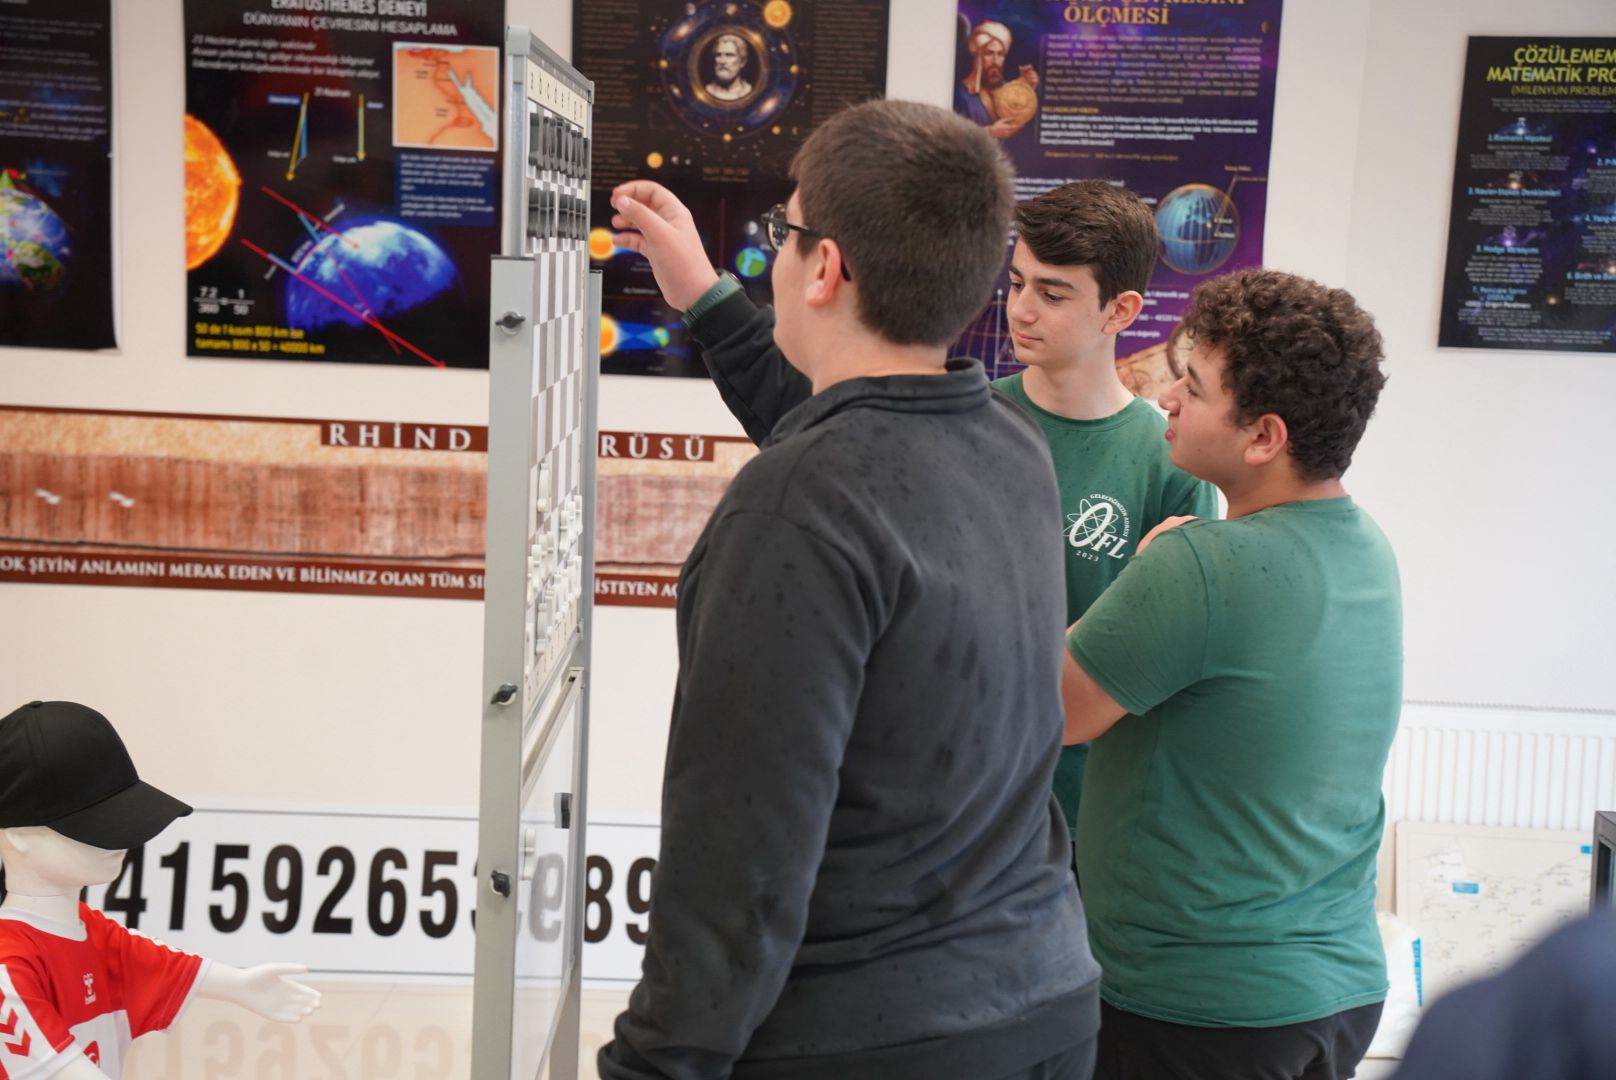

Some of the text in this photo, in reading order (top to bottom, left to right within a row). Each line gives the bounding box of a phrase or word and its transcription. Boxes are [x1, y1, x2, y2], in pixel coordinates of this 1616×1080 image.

[243, 11, 459, 36] DÜNYANIN ÇEVRESİNİ HESAPLAMA
[1063, 2, 1169, 27] ÖLÇMESİ
[1487, 64, 1582, 82] MATEMATİK
[329, 422, 705, 460] RHİND RÜSÜ
[1076, 550, 1099, 562] 2023
[28, 555, 76, 575] ŞEYİN
[81, 559, 165, 576] ANLAMINI
[169, 563, 226, 579] MERAK
[229, 565, 272, 580] EDEN
[275, 566, 296, 581] VE
[300, 566, 377, 585] BİLİNMEZ
[380, 571, 425, 586] OLAN
[428, 571, 464, 588] TÜM
[468, 574, 484, 590] SI
[594, 576, 658, 596] İSTEYEN
[101, 841, 478, 939] 4159265
